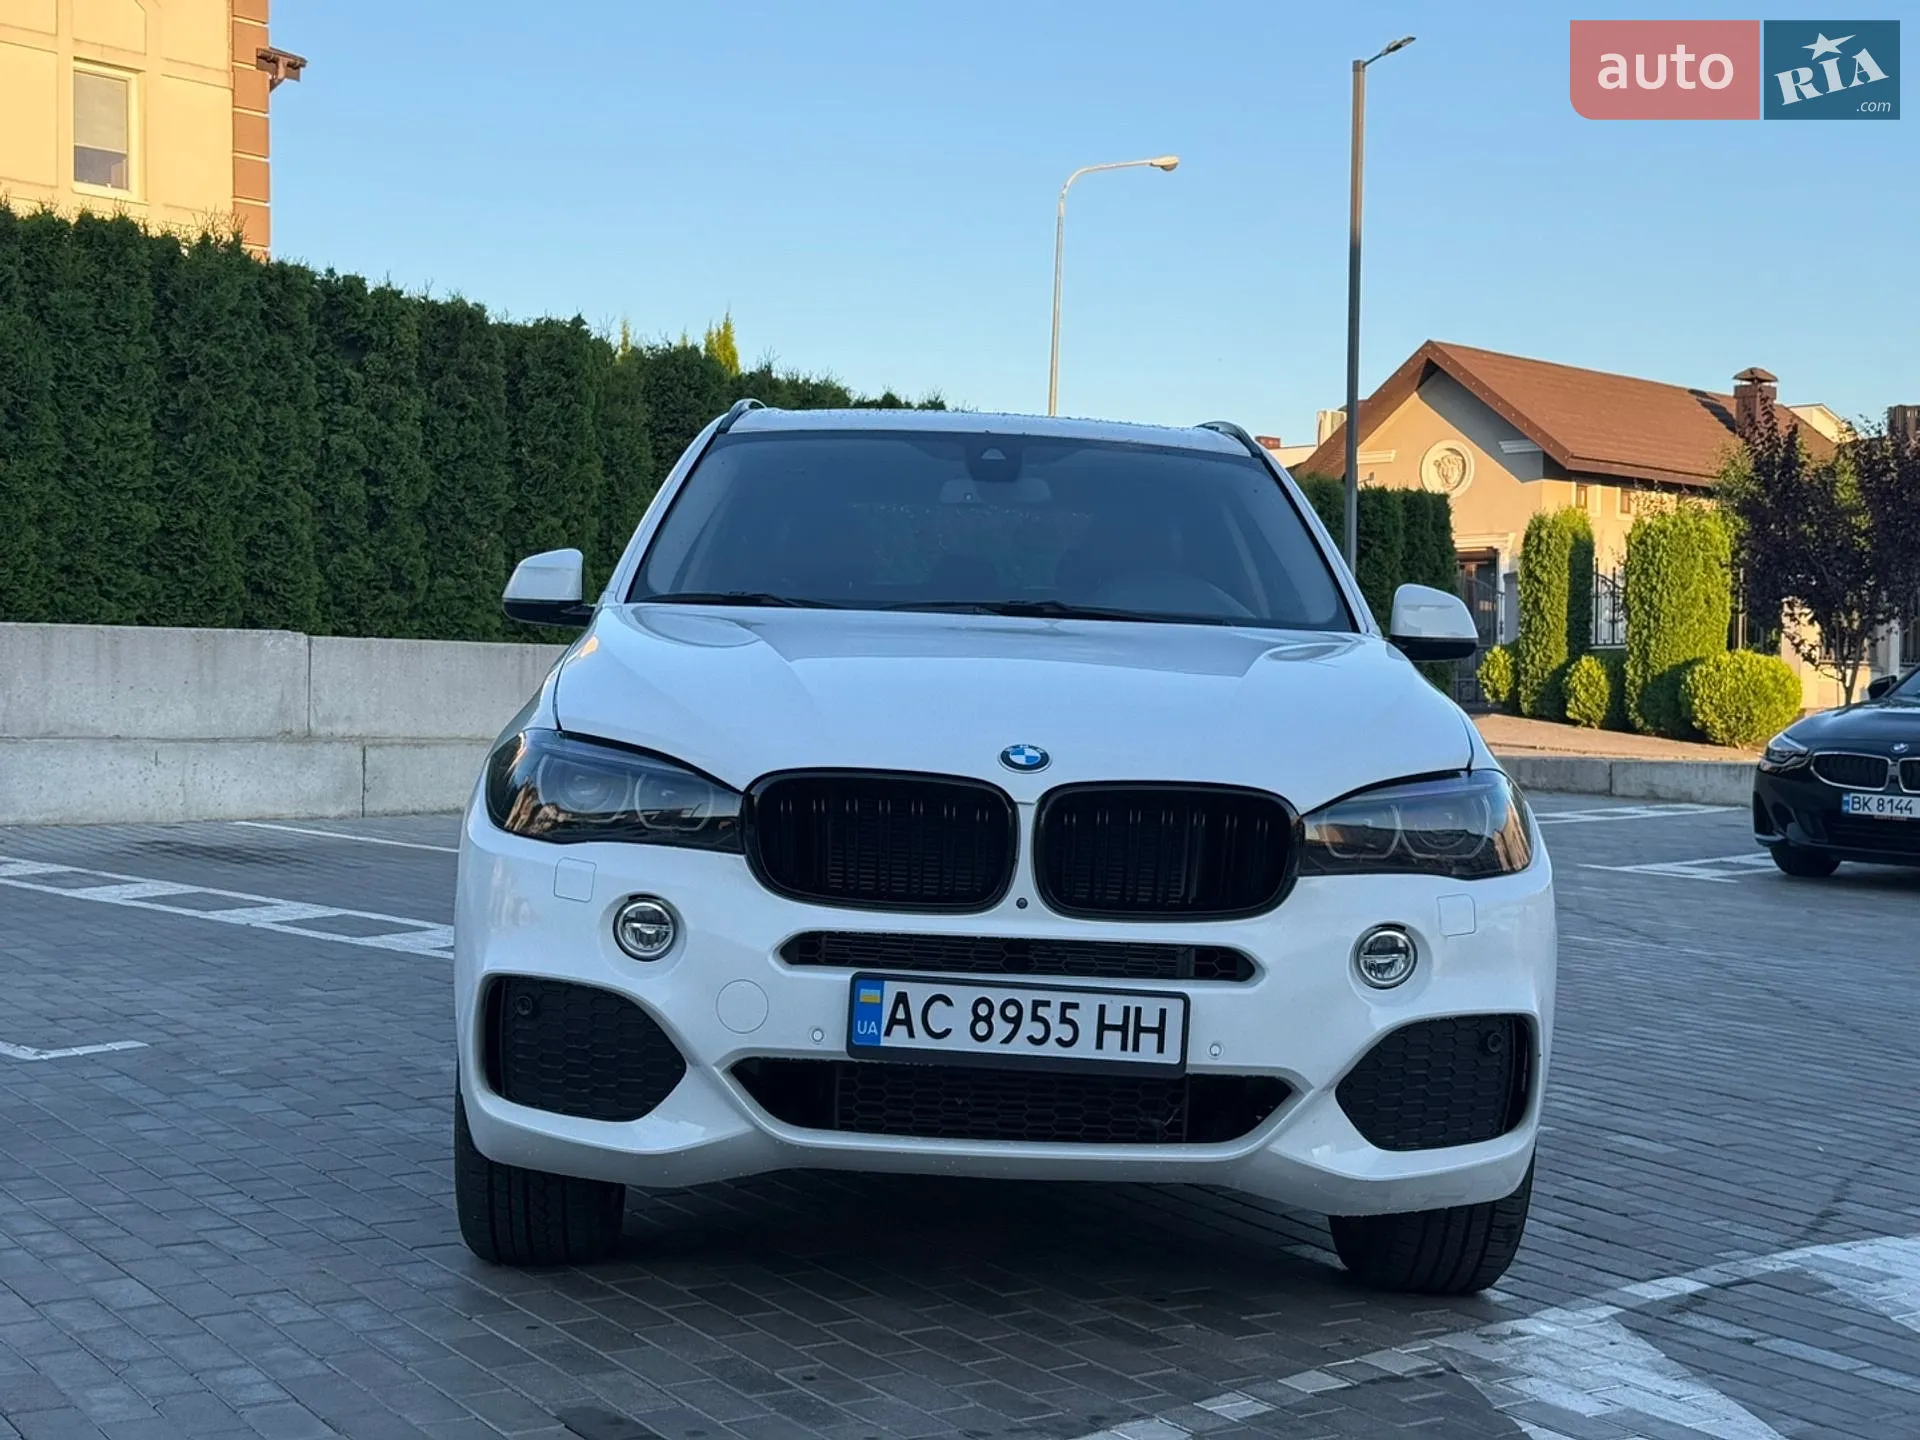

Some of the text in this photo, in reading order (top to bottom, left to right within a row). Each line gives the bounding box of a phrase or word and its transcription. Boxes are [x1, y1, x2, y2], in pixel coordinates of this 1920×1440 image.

[1851, 796, 1872, 812] BK
[1876, 798, 1912, 814] 8144
[857, 1020, 878, 1035] UA
[883, 991, 1167, 1053] AC 8955 HH
